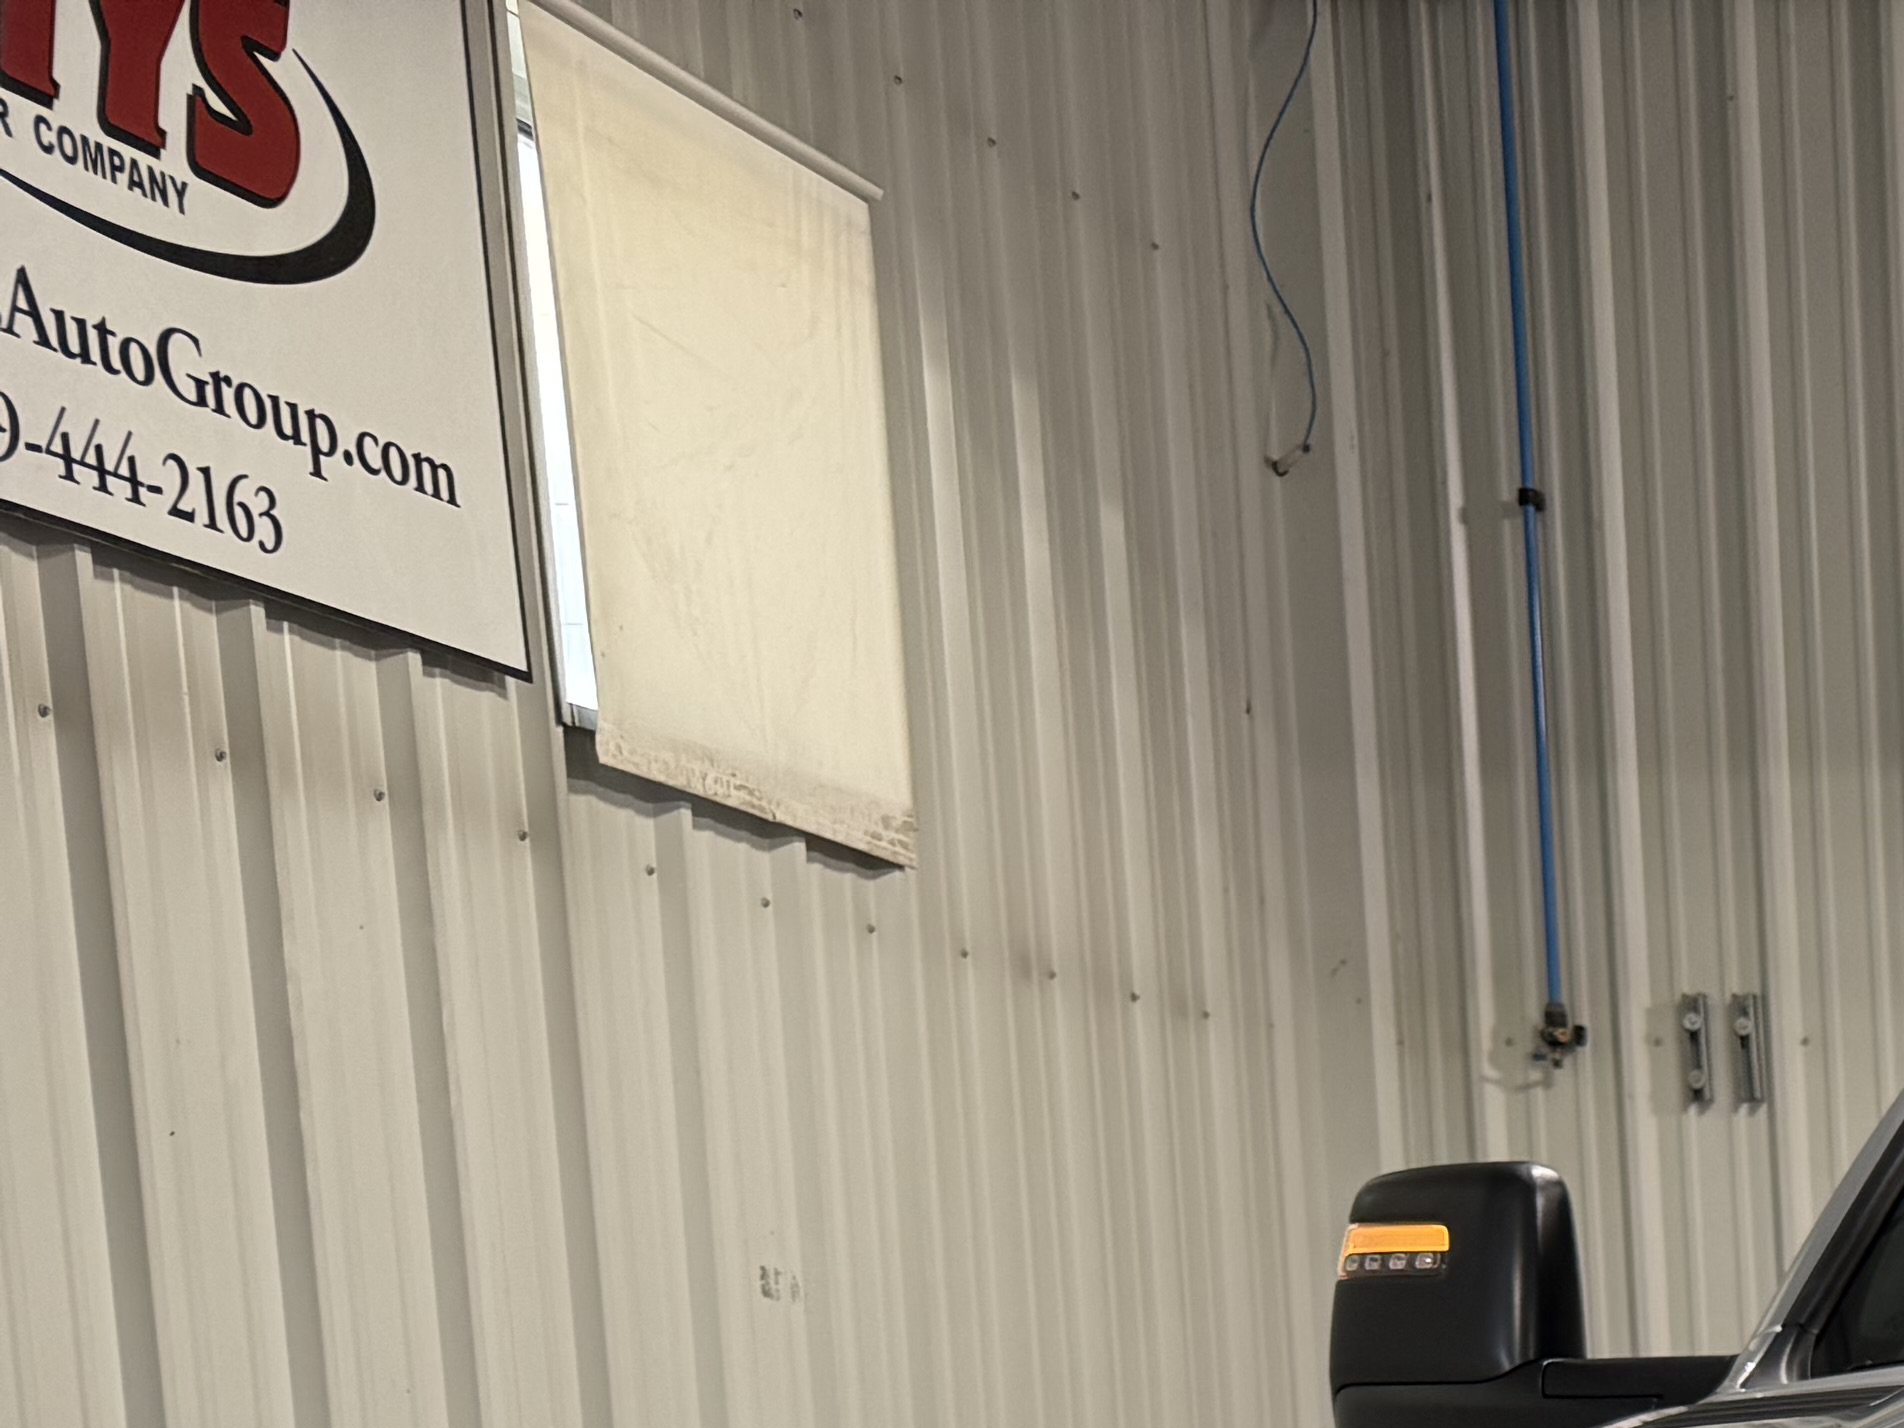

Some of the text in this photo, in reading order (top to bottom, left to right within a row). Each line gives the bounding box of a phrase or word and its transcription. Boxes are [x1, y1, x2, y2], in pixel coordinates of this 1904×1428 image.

[0, 0, 301, 208] YS
[34, 114, 189, 215] COMPANY
[0, 265, 460, 508] AutoGroup.com
